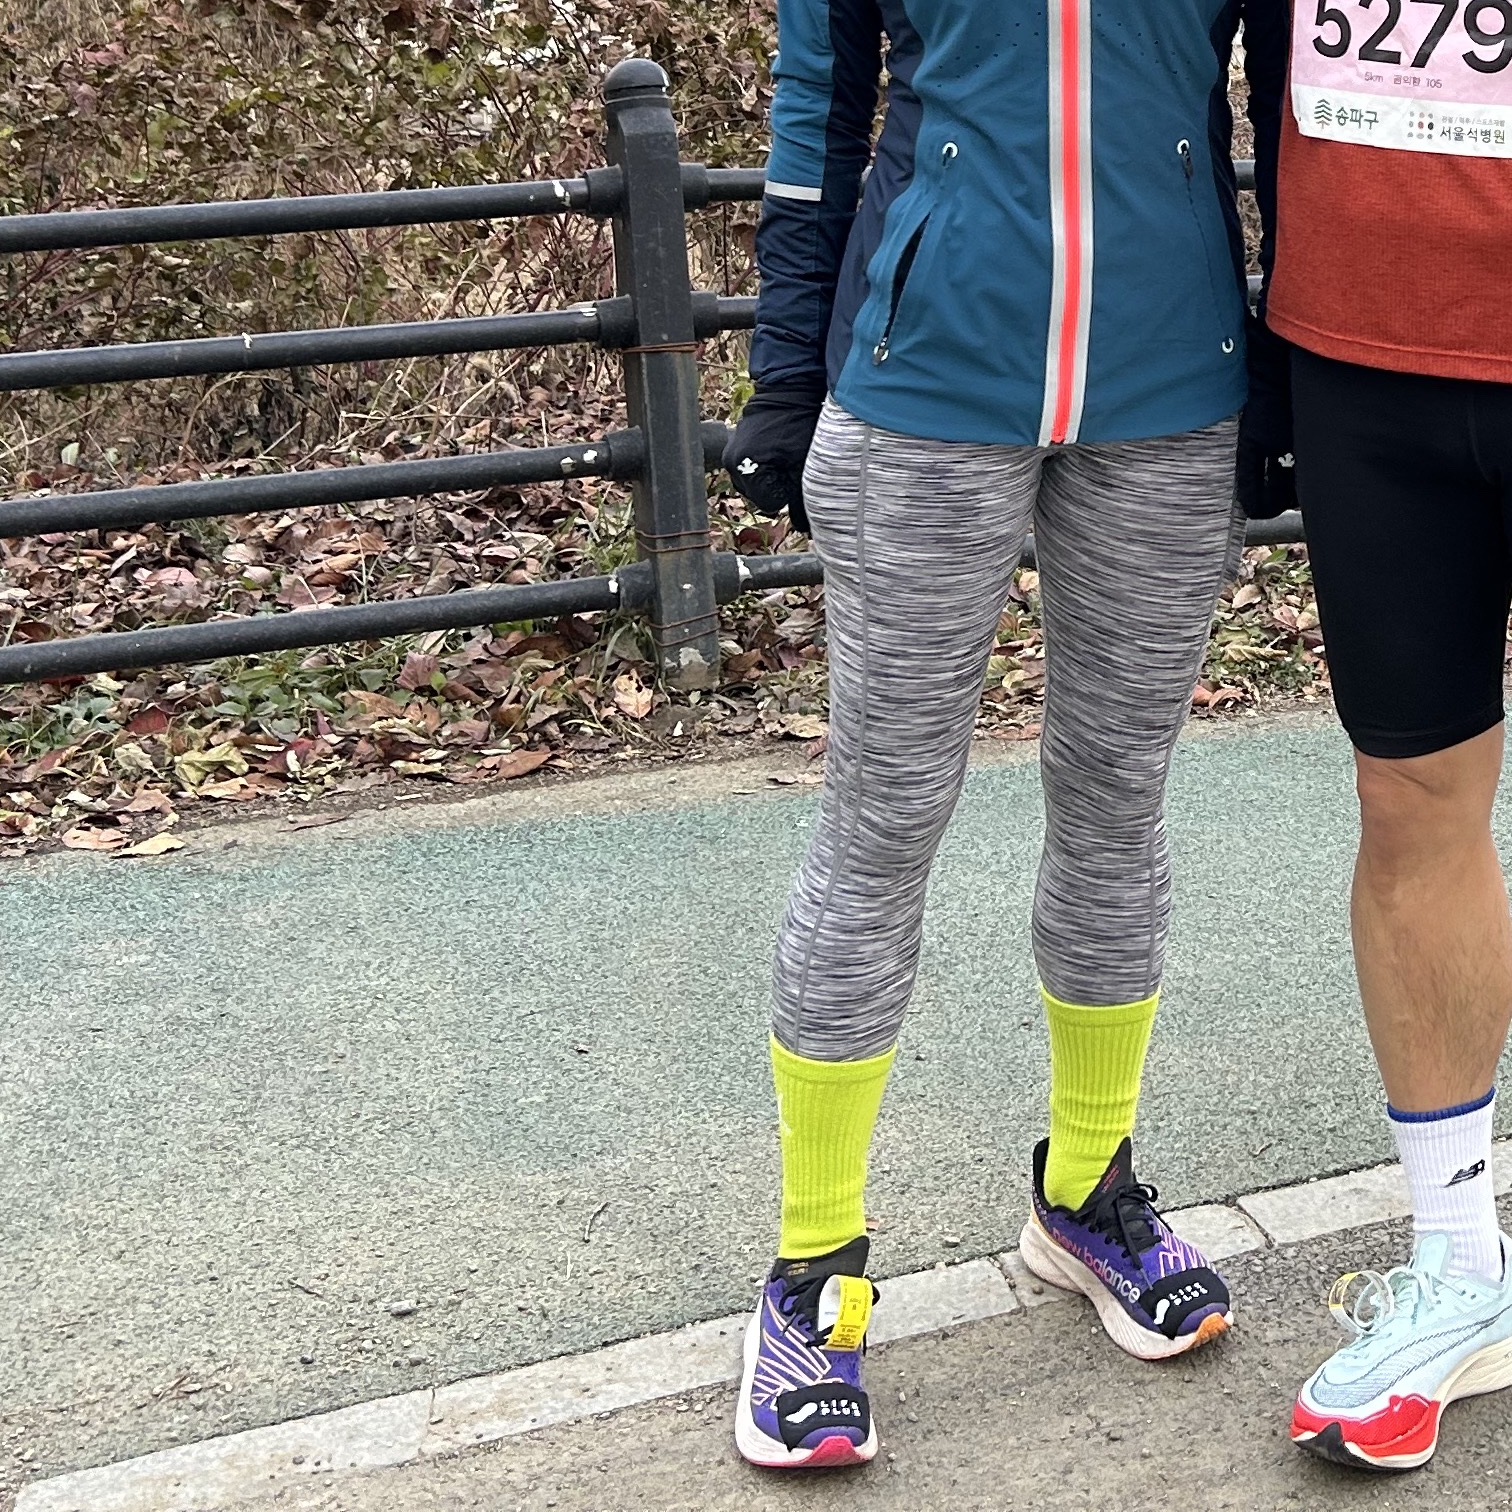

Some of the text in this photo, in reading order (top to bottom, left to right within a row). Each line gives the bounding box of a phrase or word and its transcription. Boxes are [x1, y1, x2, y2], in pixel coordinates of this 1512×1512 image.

[1335, 106, 1379, 130] 송파구
[1440, 126, 1505, 145] 서울석병원
[1052, 1226, 1141, 1304] new balance
